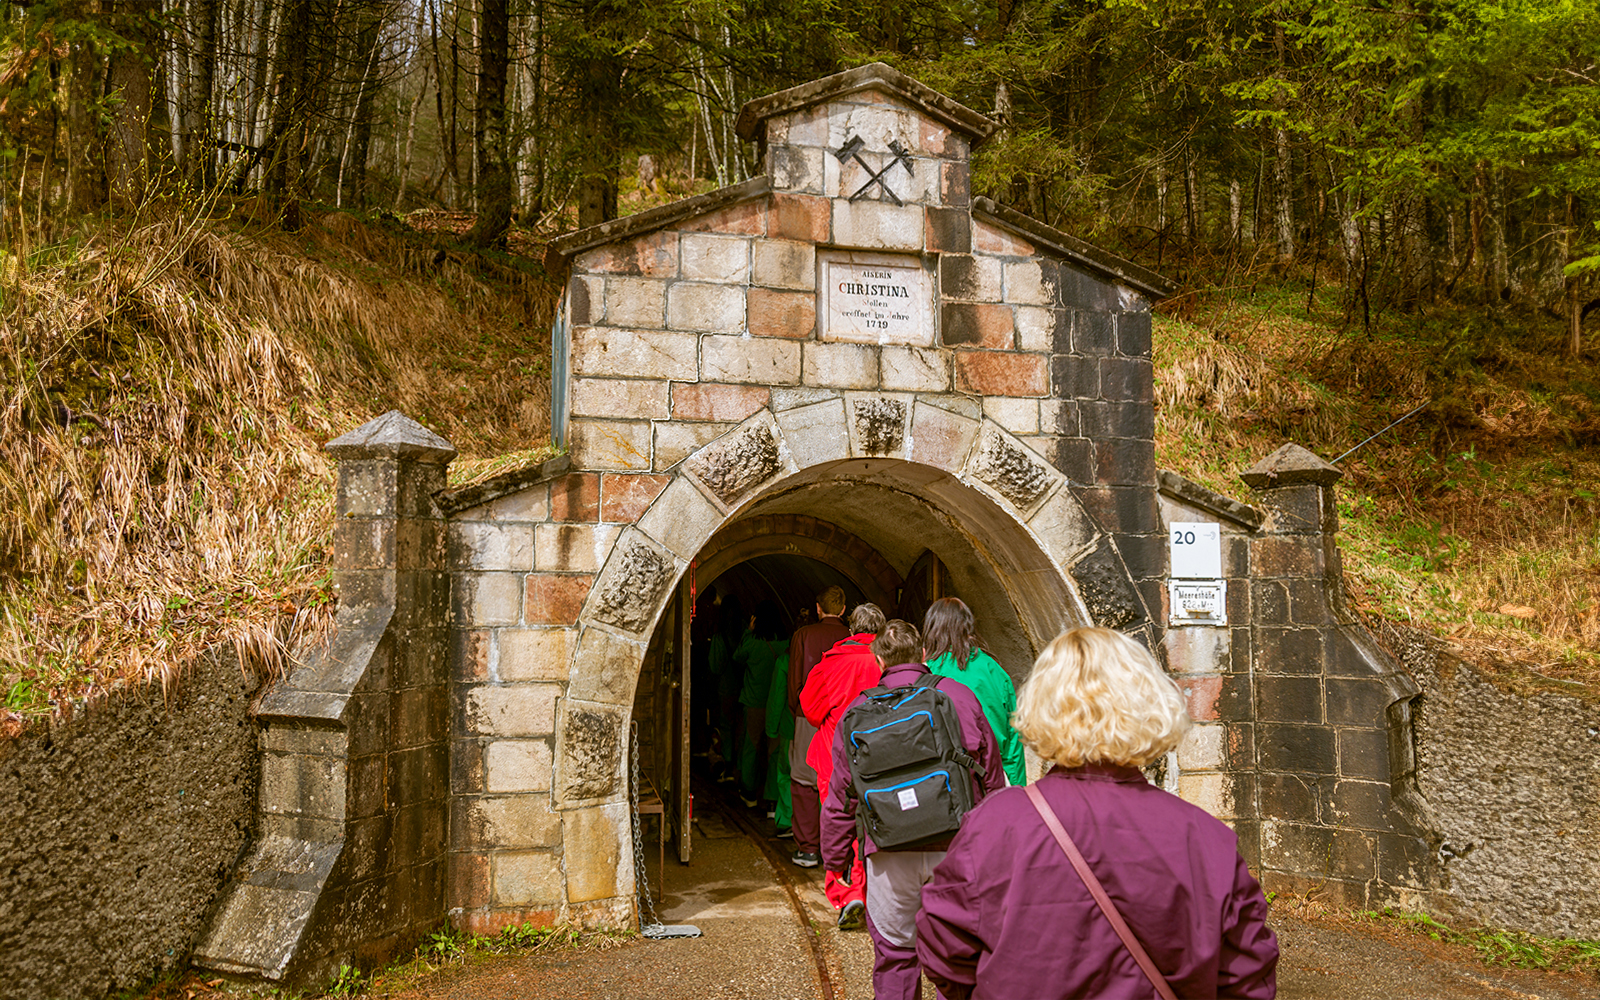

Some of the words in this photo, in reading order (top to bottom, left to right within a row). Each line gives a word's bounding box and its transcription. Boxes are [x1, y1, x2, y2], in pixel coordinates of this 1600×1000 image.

[839, 282, 909, 298] CHRISTINA
[866, 319, 888, 329] 1719
[1174, 530, 1196, 545] 20
